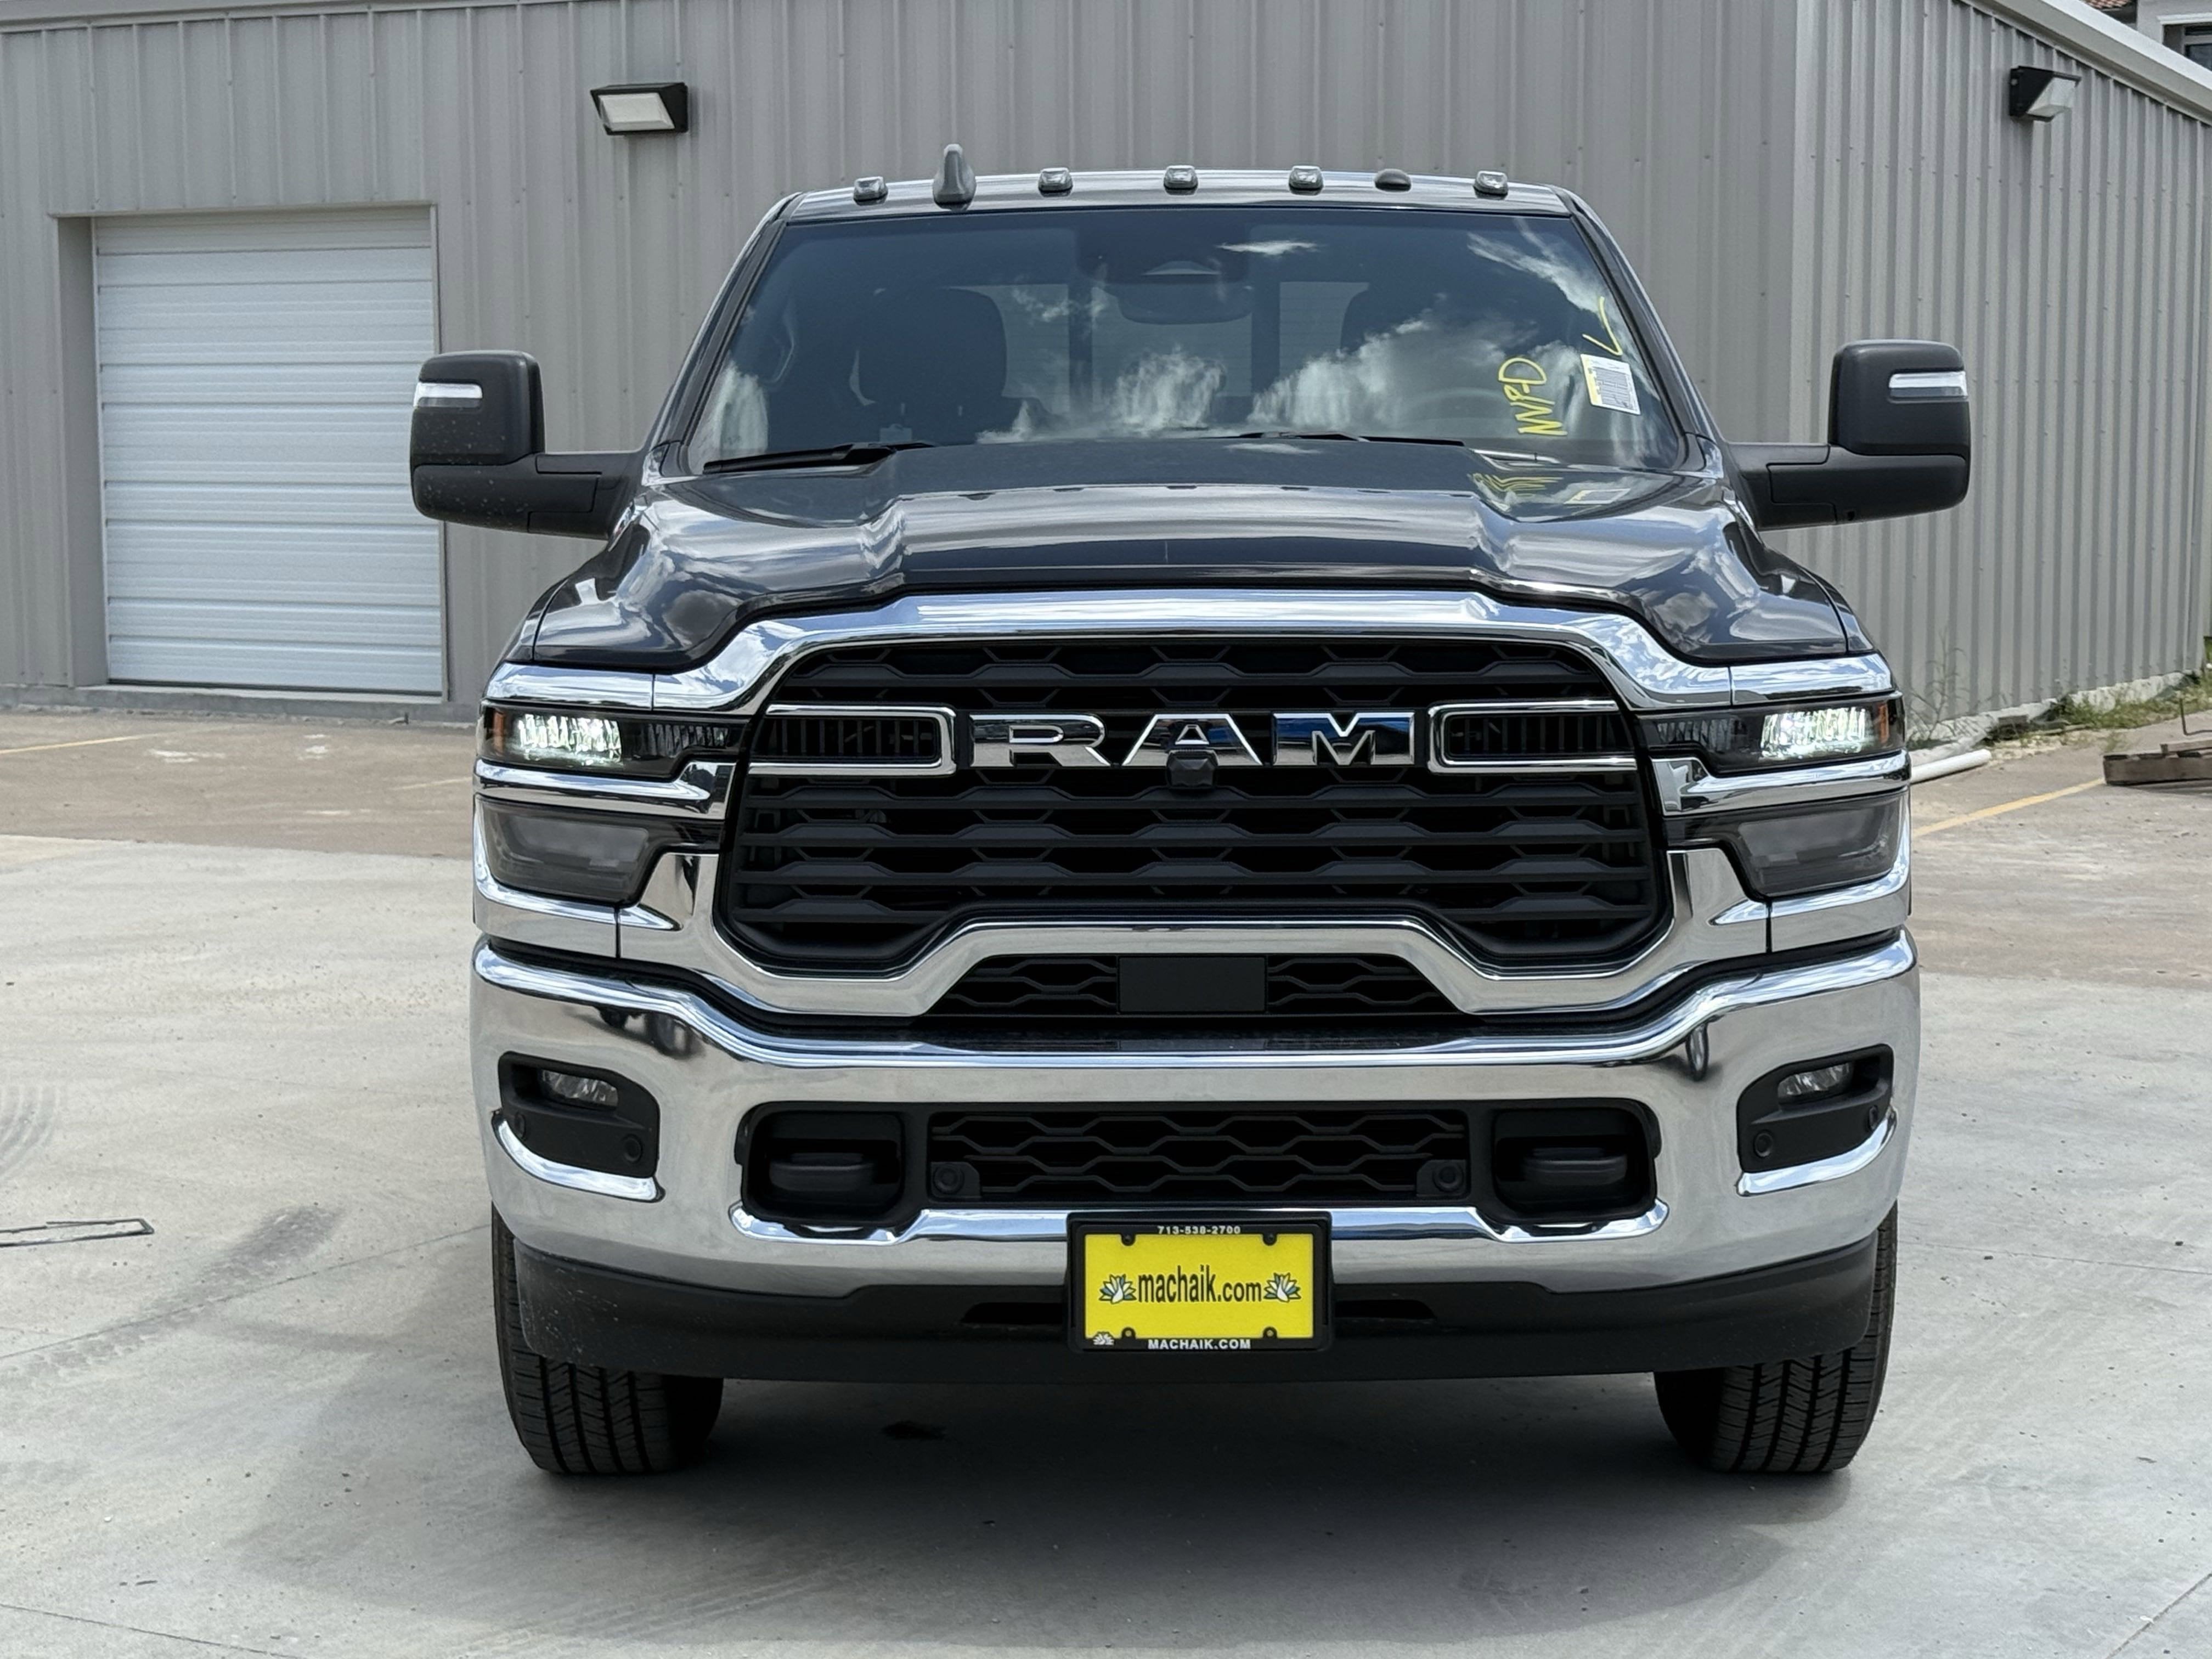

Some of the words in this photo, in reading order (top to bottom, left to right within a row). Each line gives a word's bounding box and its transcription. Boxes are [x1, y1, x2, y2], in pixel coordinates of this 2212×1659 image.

[969, 712, 1415, 766] RAM
[1157, 1226, 1241, 1234] 713-538-2700
[1138, 1264, 1262, 1303] machaik.com
[1148, 1339, 1251, 1350] MACHAIK.COM
